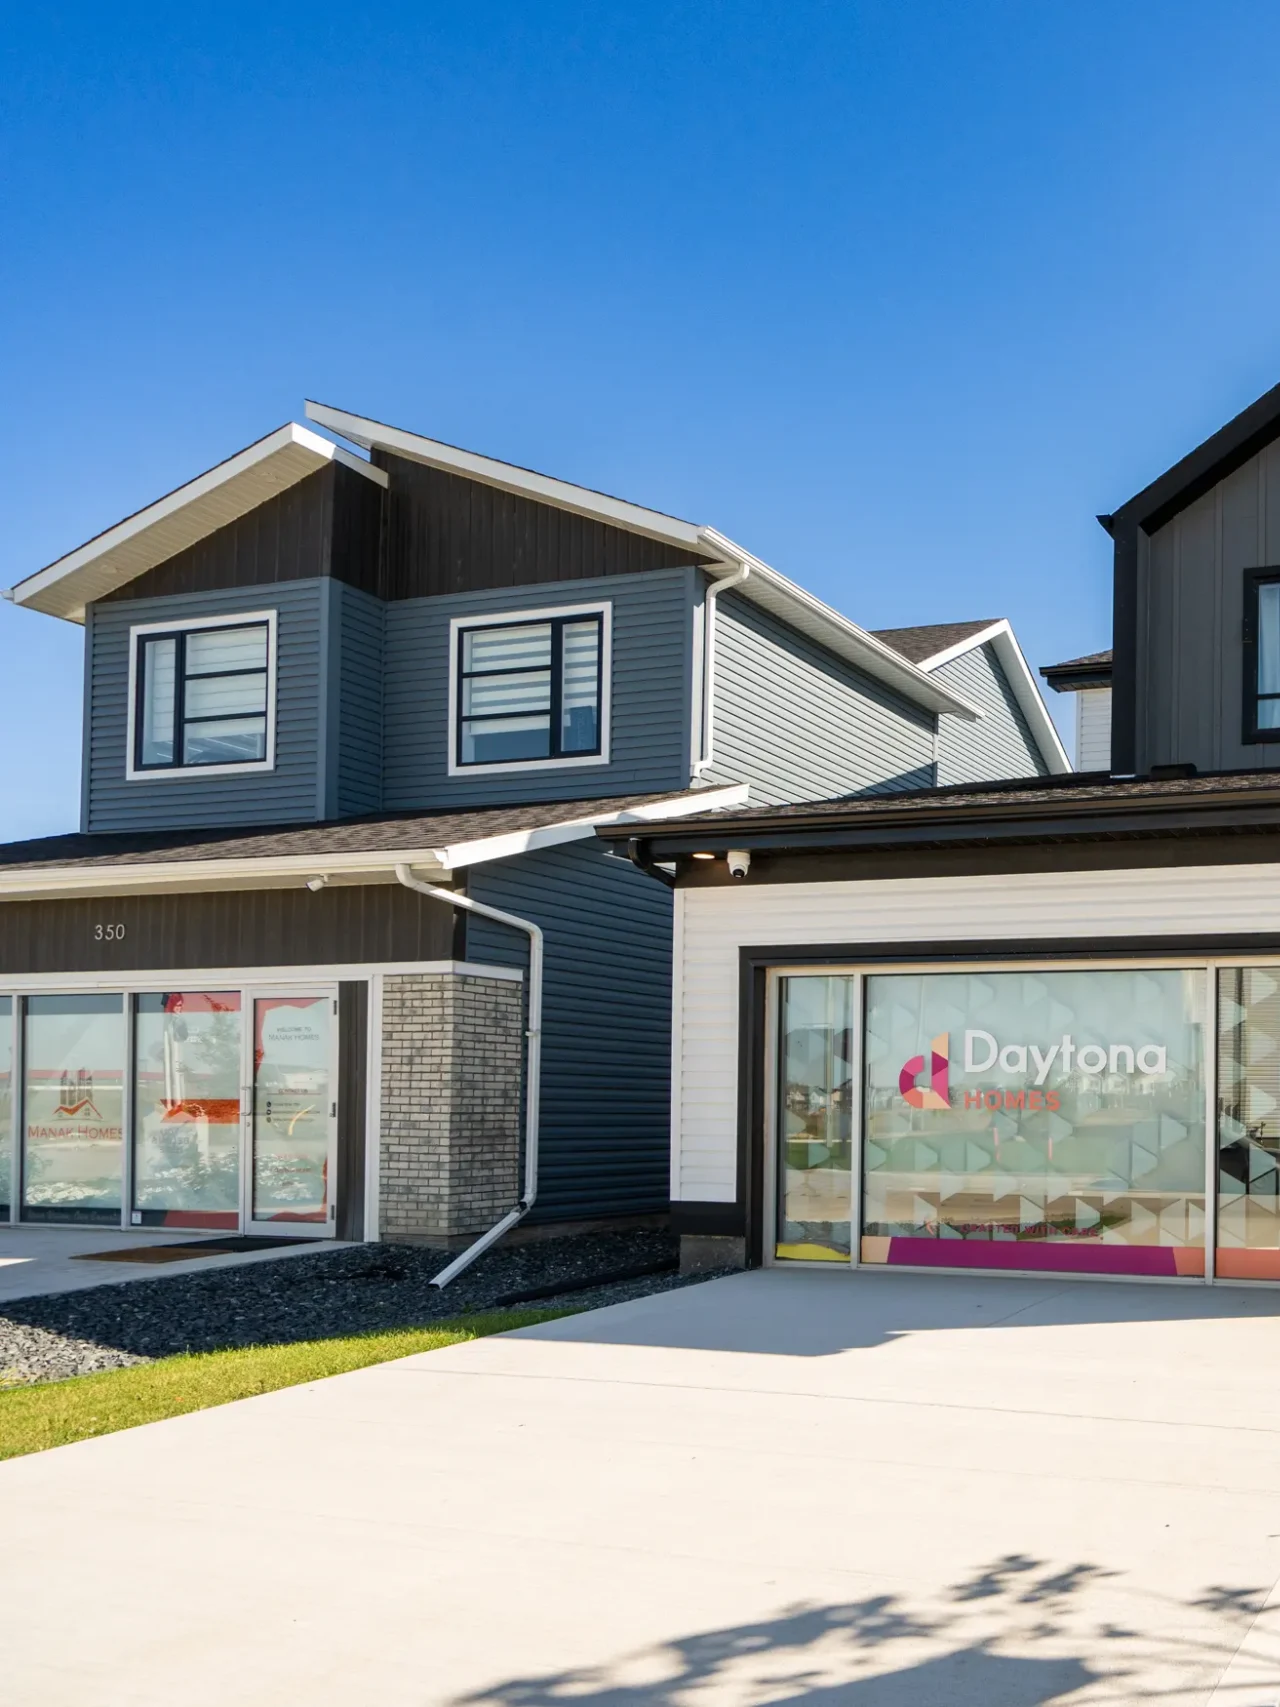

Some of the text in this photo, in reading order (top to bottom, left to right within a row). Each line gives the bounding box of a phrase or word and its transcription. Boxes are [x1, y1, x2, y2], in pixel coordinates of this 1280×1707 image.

[94, 924, 126, 940] 350
[964, 1029, 1167, 1086] Daytona
[964, 1089, 1061, 1111] HOMES
[28, 1125, 73, 1140] MANAK
[1024, 1224, 1058, 1237] WITH
